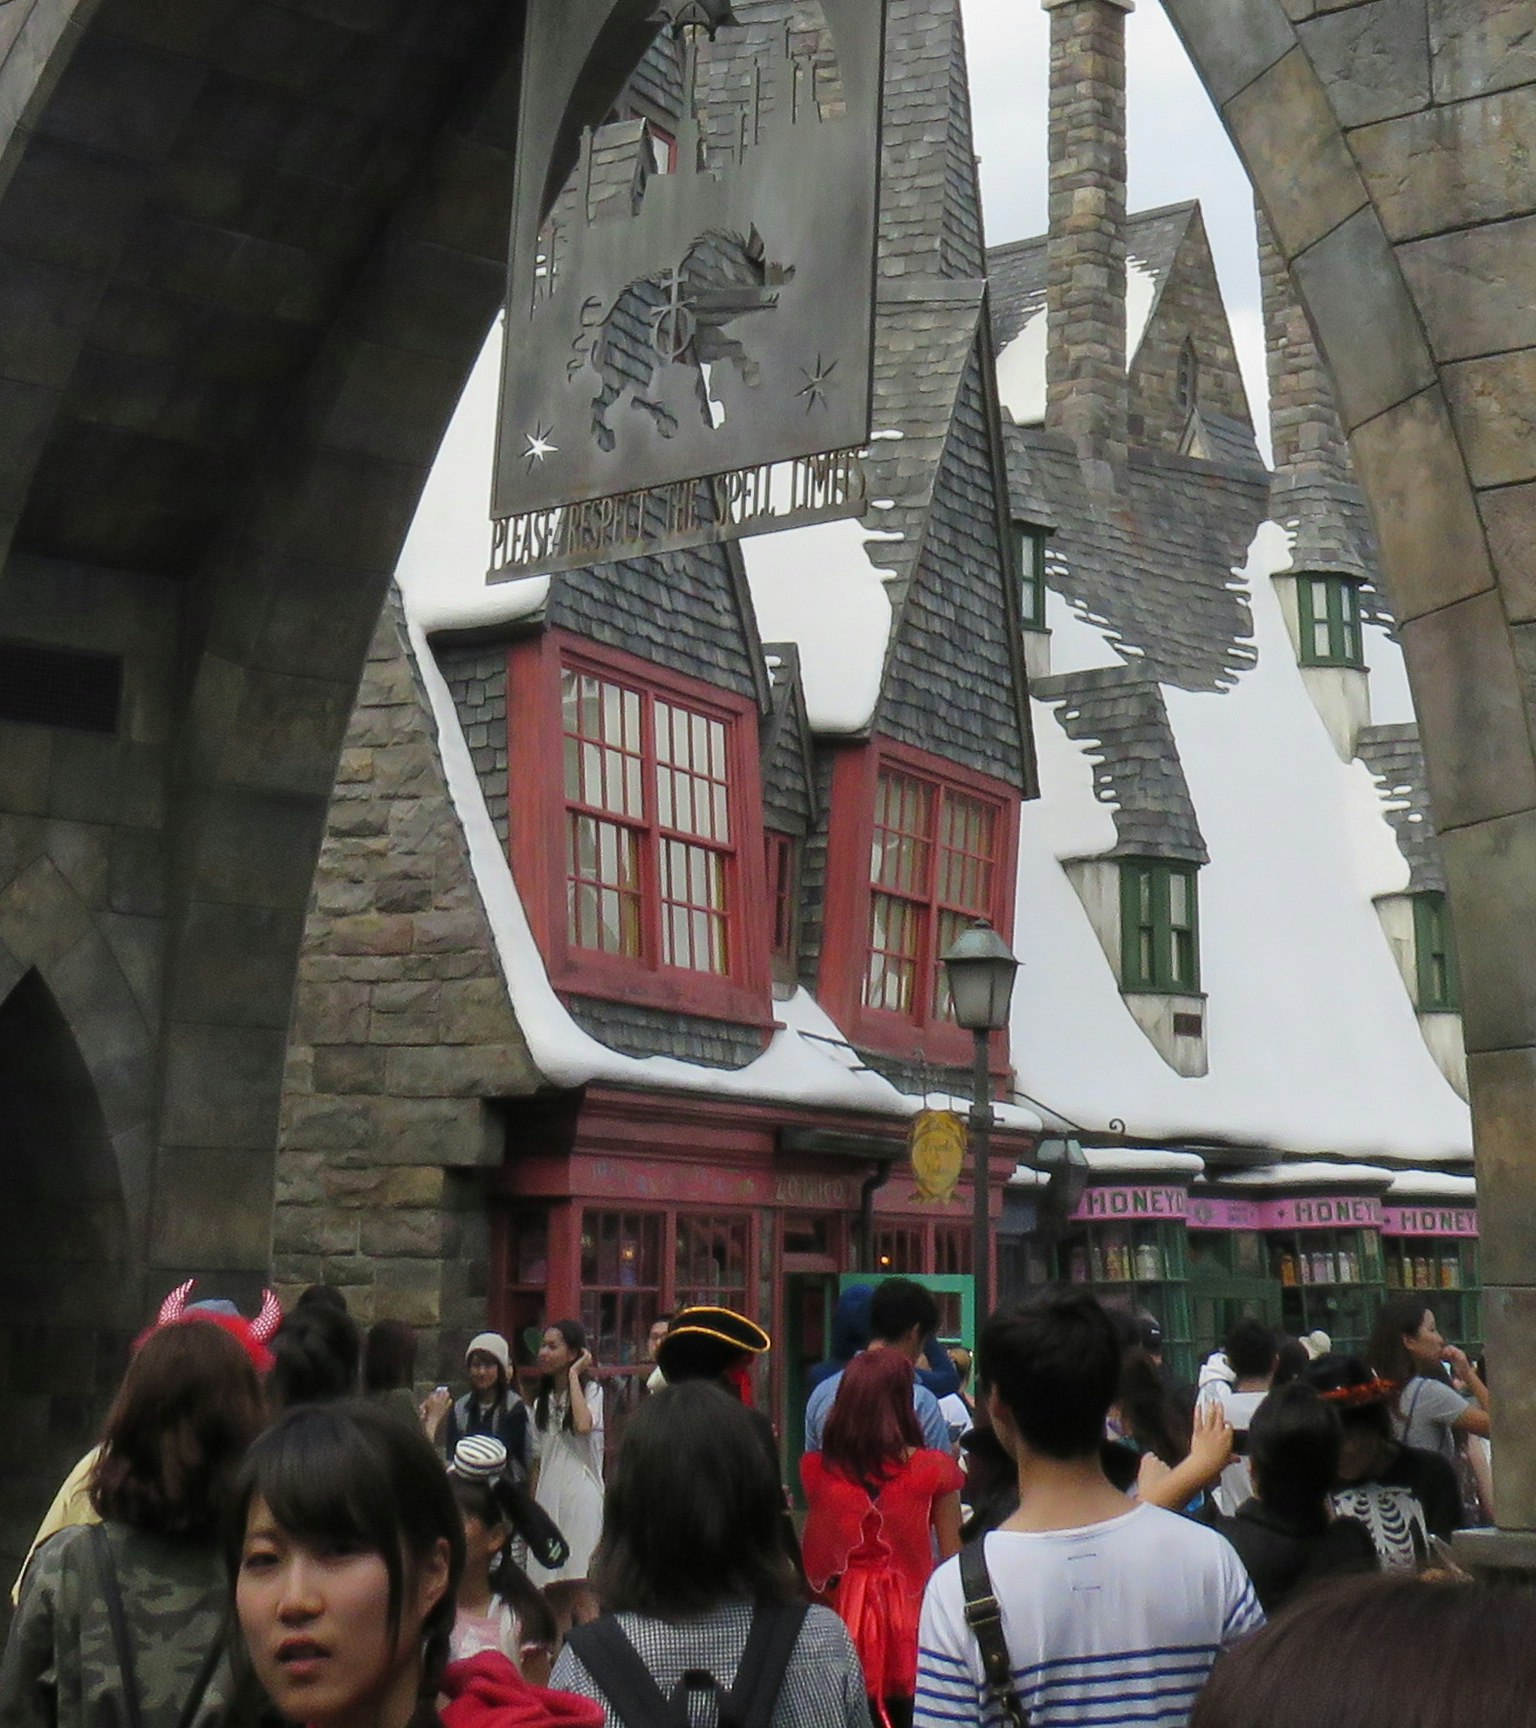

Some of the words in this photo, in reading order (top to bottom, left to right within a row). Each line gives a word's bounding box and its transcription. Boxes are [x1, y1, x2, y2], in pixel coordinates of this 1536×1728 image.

[492, 508, 557, 570] PLEASE
[567, 490, 649, 554] RESPECT
[664, 479, 701, 535] THE
[714, 465, 776, 525] SPELL
[790, 448, 866, 512] LIMITS
